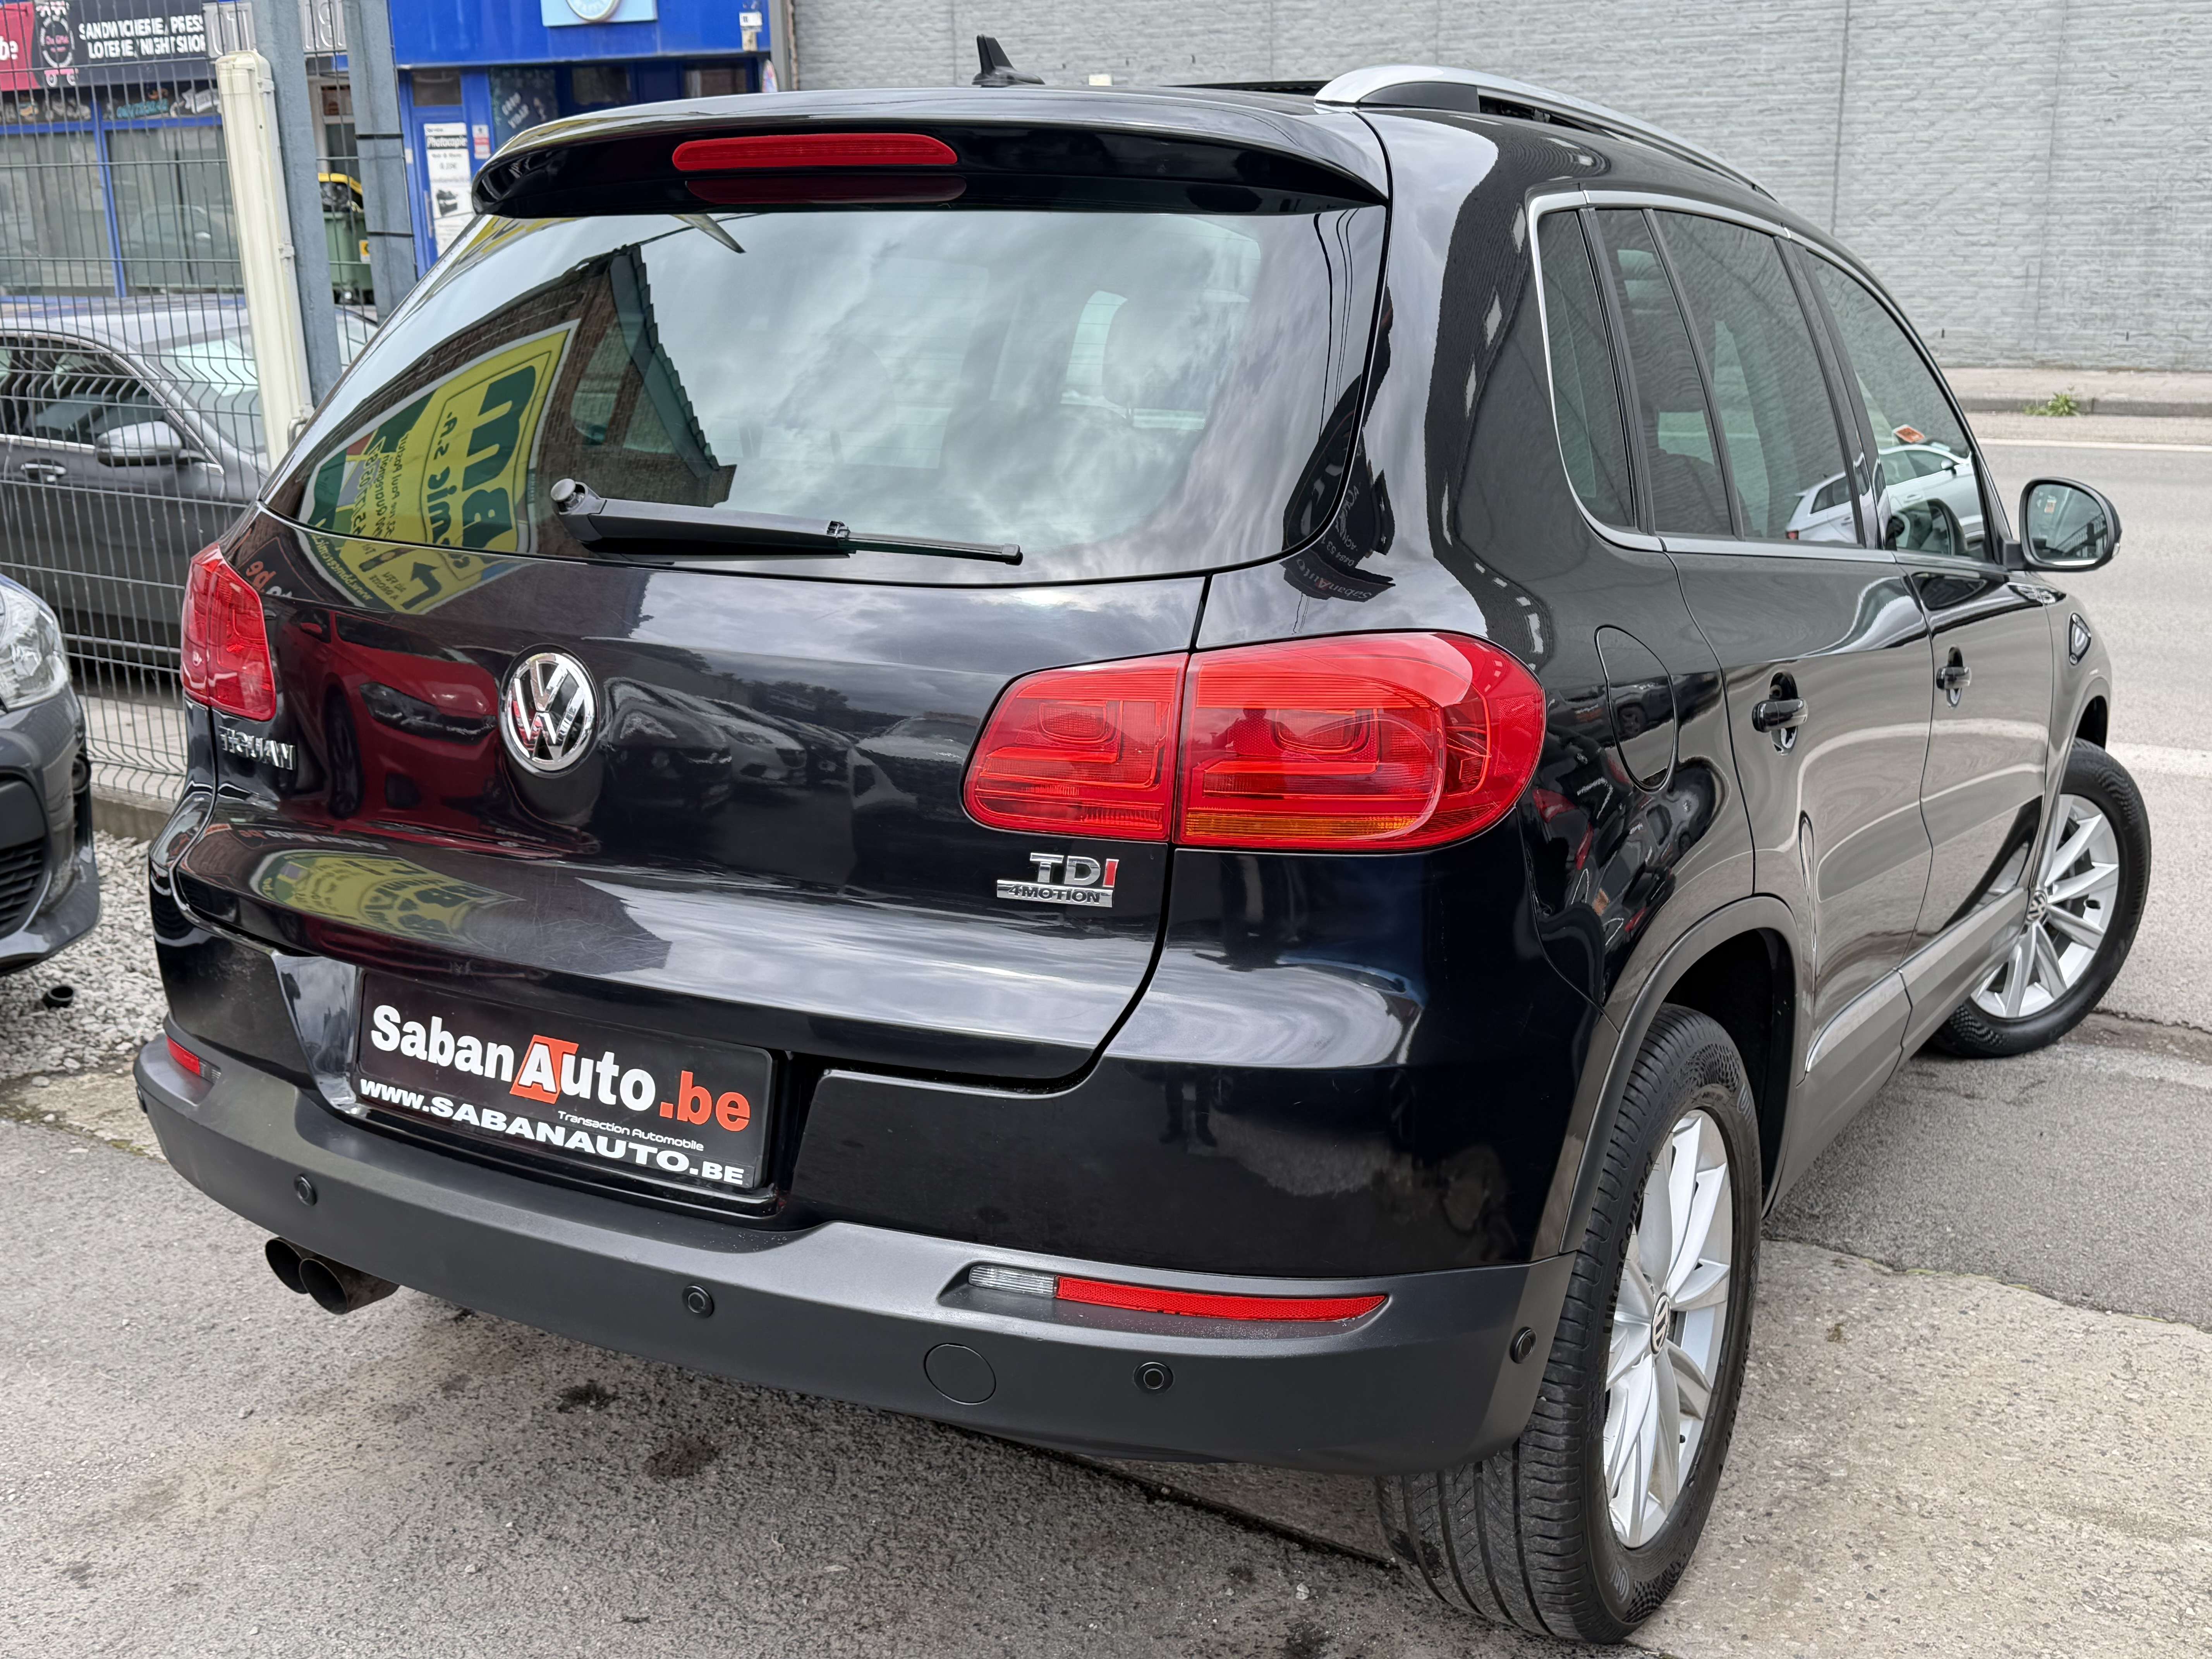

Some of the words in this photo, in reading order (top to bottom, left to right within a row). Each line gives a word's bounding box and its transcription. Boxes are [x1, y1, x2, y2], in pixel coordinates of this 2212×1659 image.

[1030, 852, 1119, 888] TDI
[1007, 884, 1100, 905] 4MOTION
[371, 1004, 750, 1132] SabanAuto.be
[558, 1109, 630, 1137] Transaction
[631, 1127, 704, 1152] Automobile
